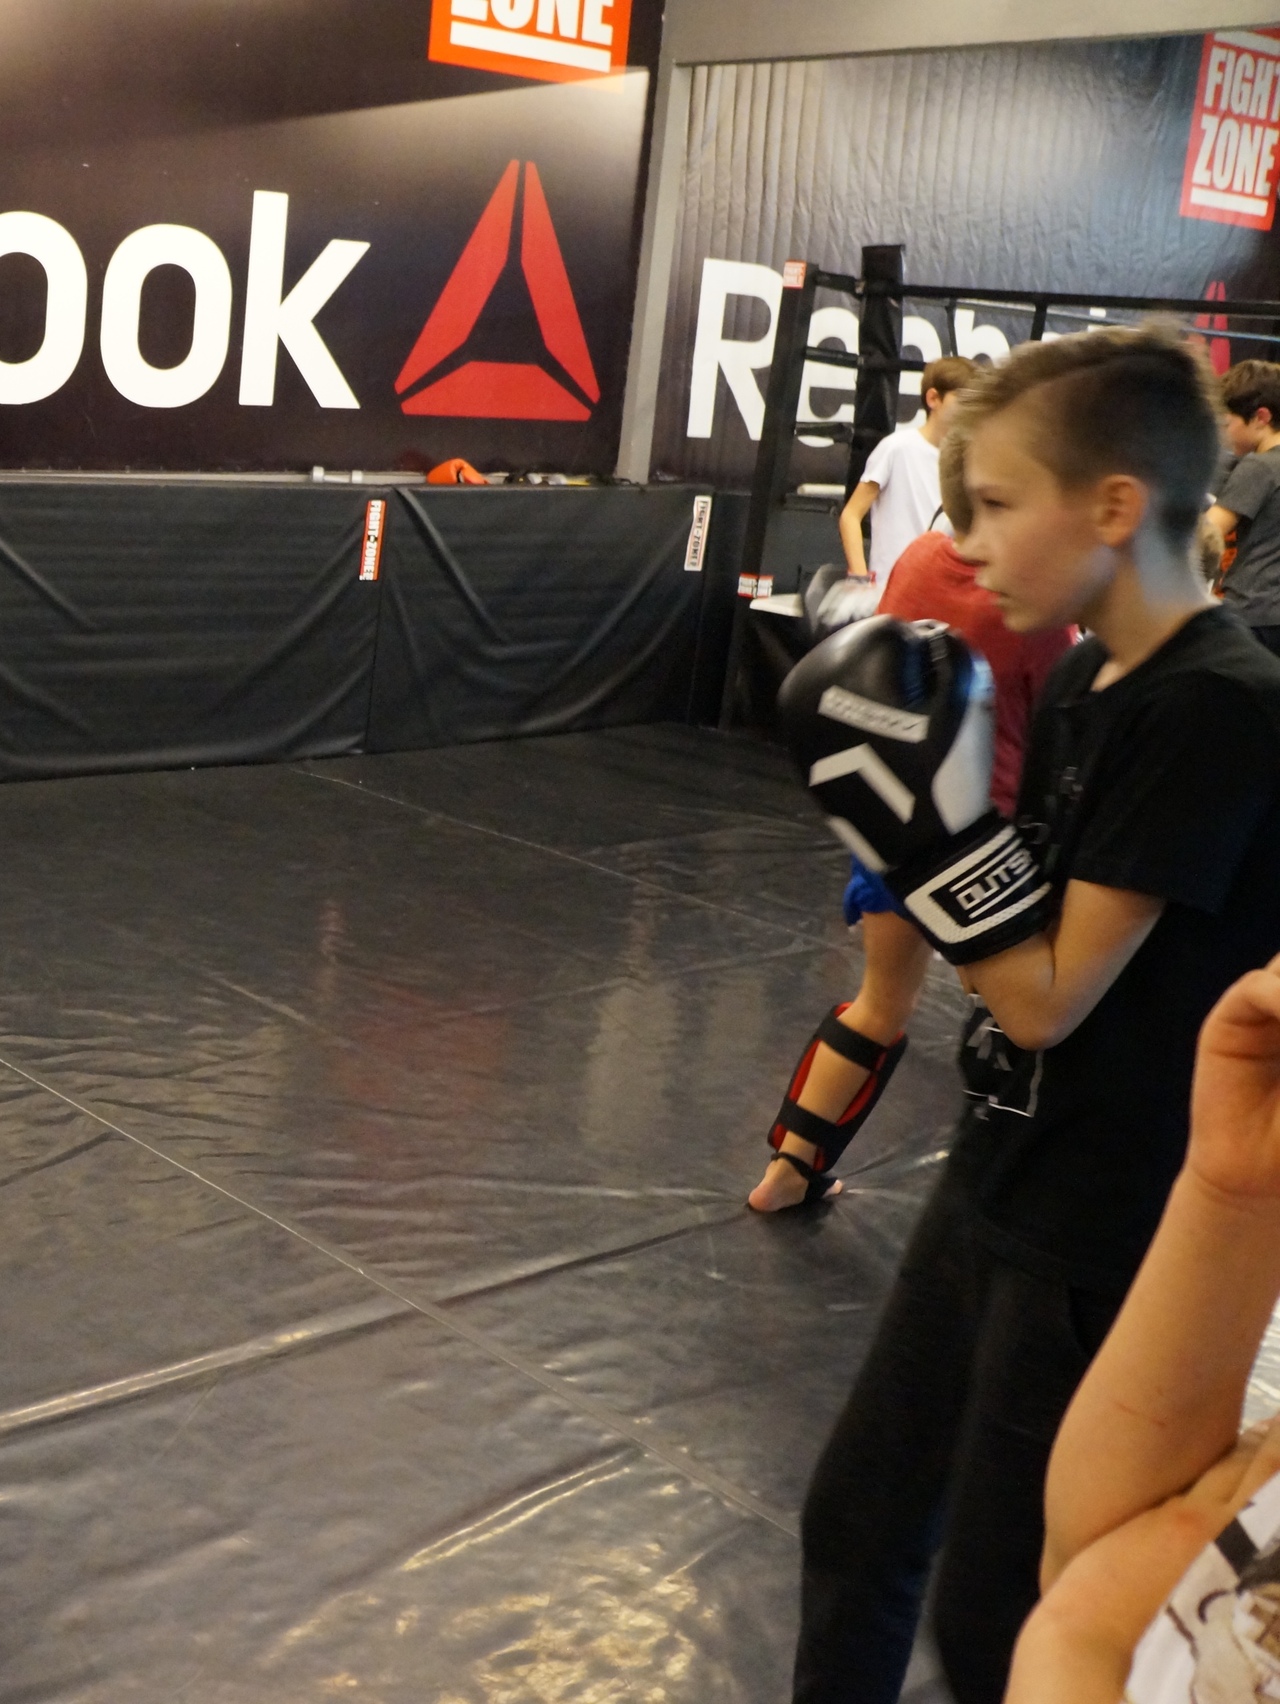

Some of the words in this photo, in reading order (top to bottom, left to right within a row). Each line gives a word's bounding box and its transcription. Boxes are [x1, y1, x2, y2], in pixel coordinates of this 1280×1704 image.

[451, 0, 614, 46] NE
[1192, 113, 1279, 197] ZONE
[687, 258, 1107, 448] Reeb
